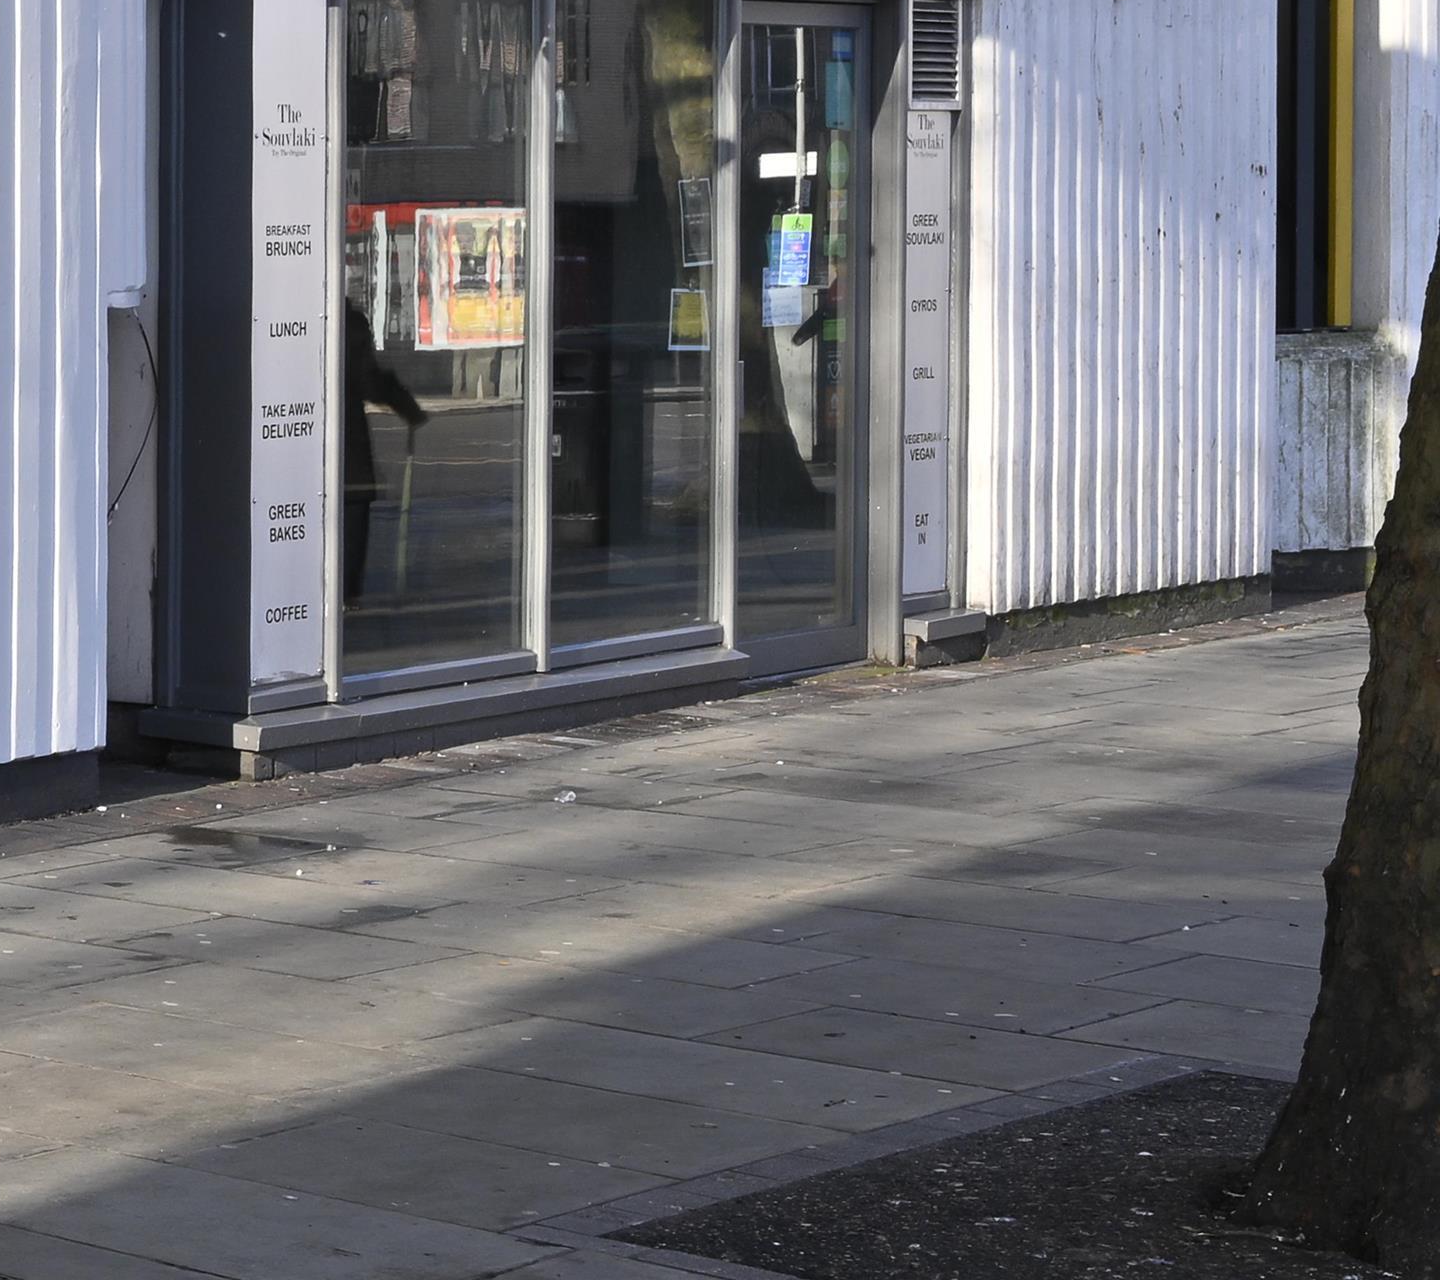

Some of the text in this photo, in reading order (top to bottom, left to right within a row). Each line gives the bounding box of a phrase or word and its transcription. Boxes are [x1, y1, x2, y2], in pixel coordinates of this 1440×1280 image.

[278, 104, 301, 123] The
[918, 114, 935, 130] The
[263, 128, 315, 146] Souvlaki
[913, 214, 938, 227] GREEK
[266, 224, 311, 236] BREAKFAST
[906, 232, 944, 245] SOUVLAKI
[266, 241, 311, 256] BRUNCH
[911, 300, 937, 312] GYROS
[270, 321, 307, 337] LUNCH
[913, 367, 934, 379] GRILL
[262, 402, 315, 418] TAKE AWAY
[262, 421, 314, 439] DELIVERY
[910, 448, 935, 461] VEGAN
[269, 503, 306, 520] GREEK
[915, 514, 929, 527] EAT
[270, 524, 305, 543] BAKES
[918, 533, 926, 544] IN
[266, 604, 308, 624] COFFEE
